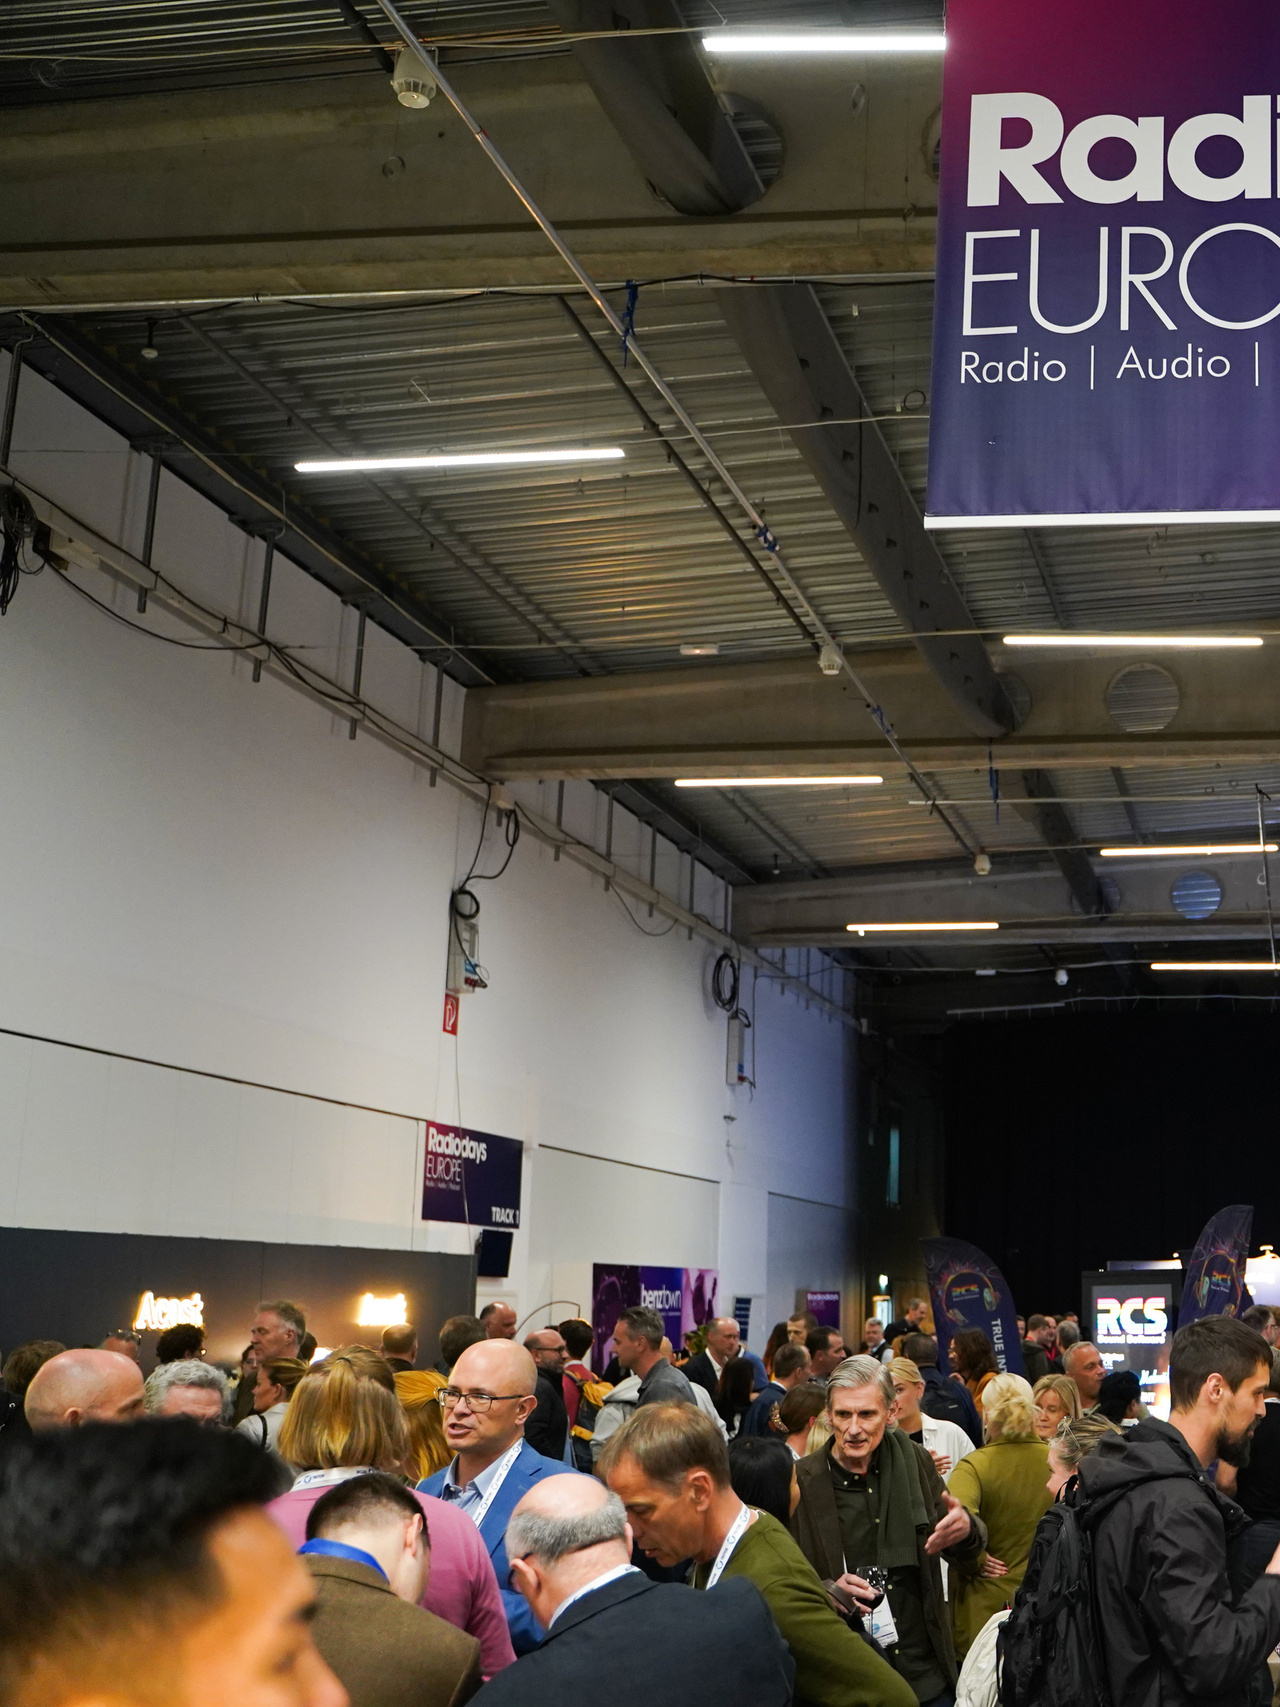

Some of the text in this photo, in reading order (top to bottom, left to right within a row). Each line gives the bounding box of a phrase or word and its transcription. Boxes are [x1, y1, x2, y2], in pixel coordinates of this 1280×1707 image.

[960, 345, 1067, 384] Radio
[1116, 345, 1231, 380] Audio
[427, 1126, 488, 1164] Radiodays
[426, 1155, 462, 1182] EUROPE
[491, 1206, 515, 1224] TRACK
[641, 1283, 682, 1309] benztown
[1096, 1297, 1168, 1335] RCS
[991, 1317, 1005, 1353] TRUE
